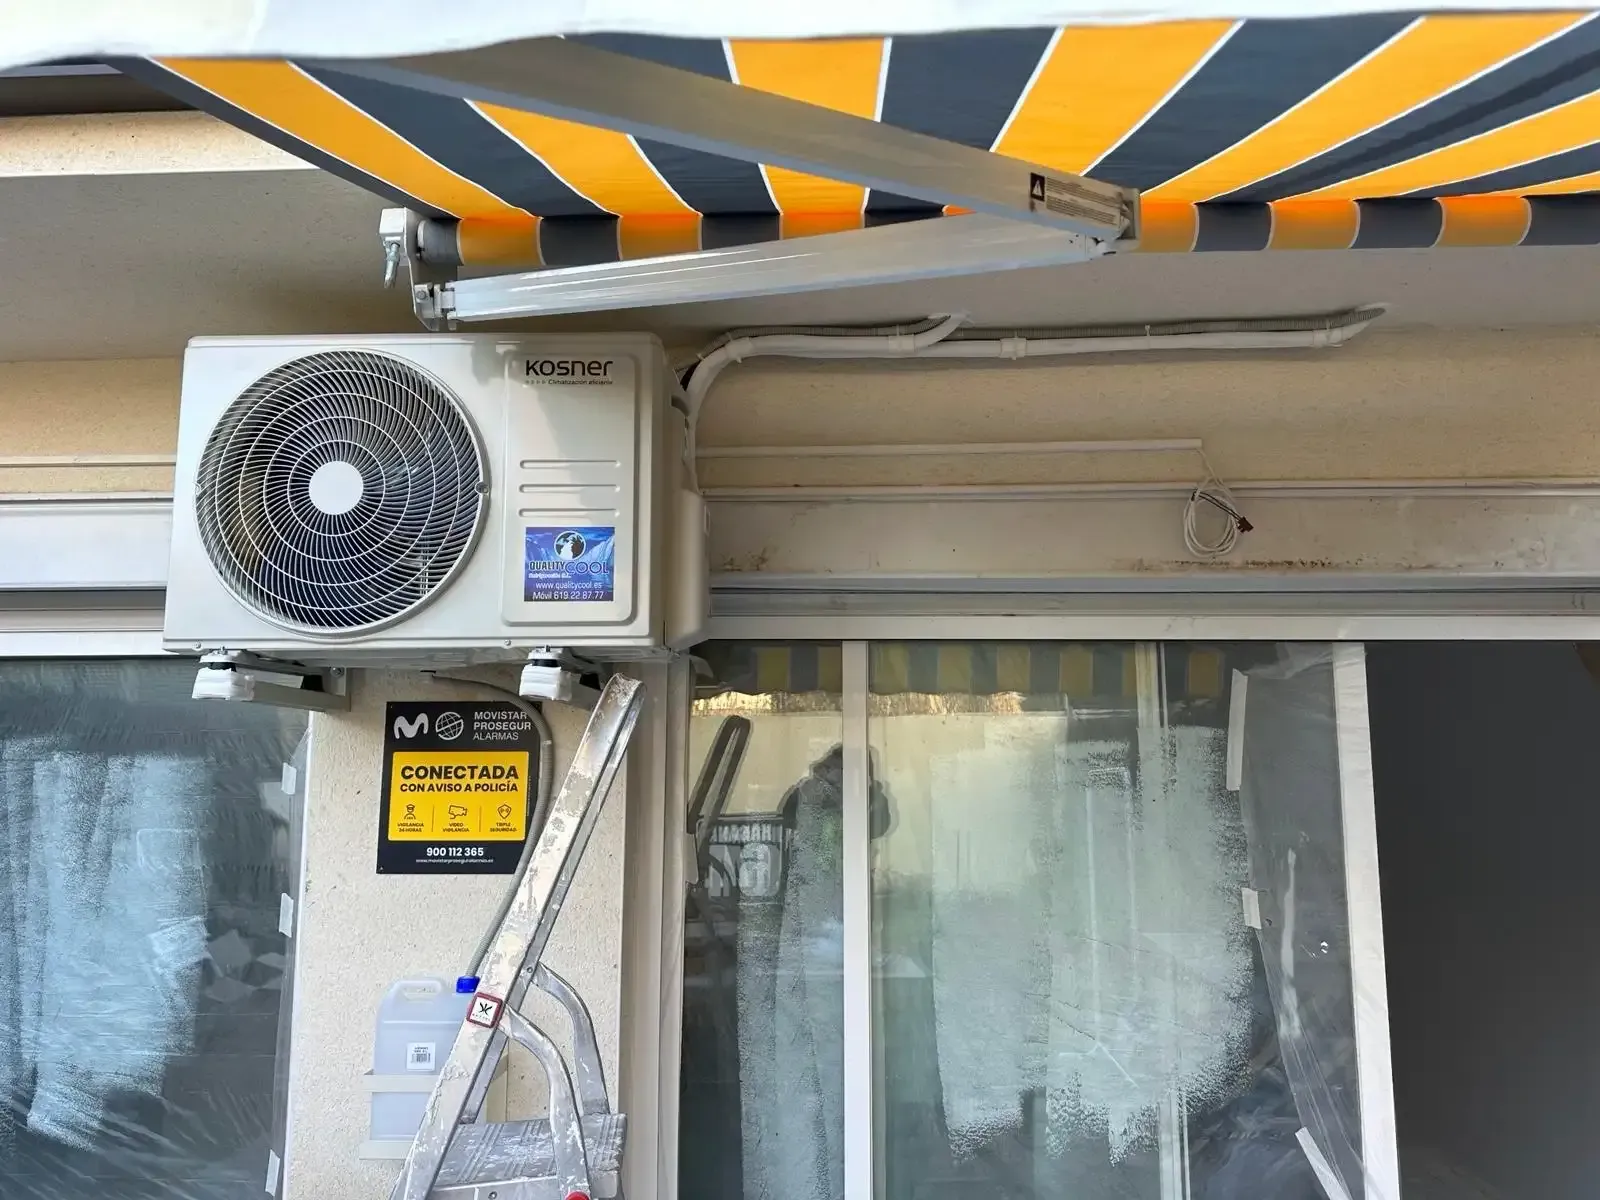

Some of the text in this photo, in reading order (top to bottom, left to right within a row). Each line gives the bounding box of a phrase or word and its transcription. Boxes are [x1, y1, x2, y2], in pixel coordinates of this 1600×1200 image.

[535, 580, 602, 590] www.qualitycool.es
[532, 591, 552, 600] Móvil
[474, 711, 527, 720] MOVISTAR
[473, 721, 532, 730] PROSEGUR
[472, 732, 519, 741] ALARMAS
[400, 765, 519, 780] CONECTADA
[400, 780, 518, 792] CON AVISO A POLICÍA
[426, 847, 484, 857] 900 112 365
